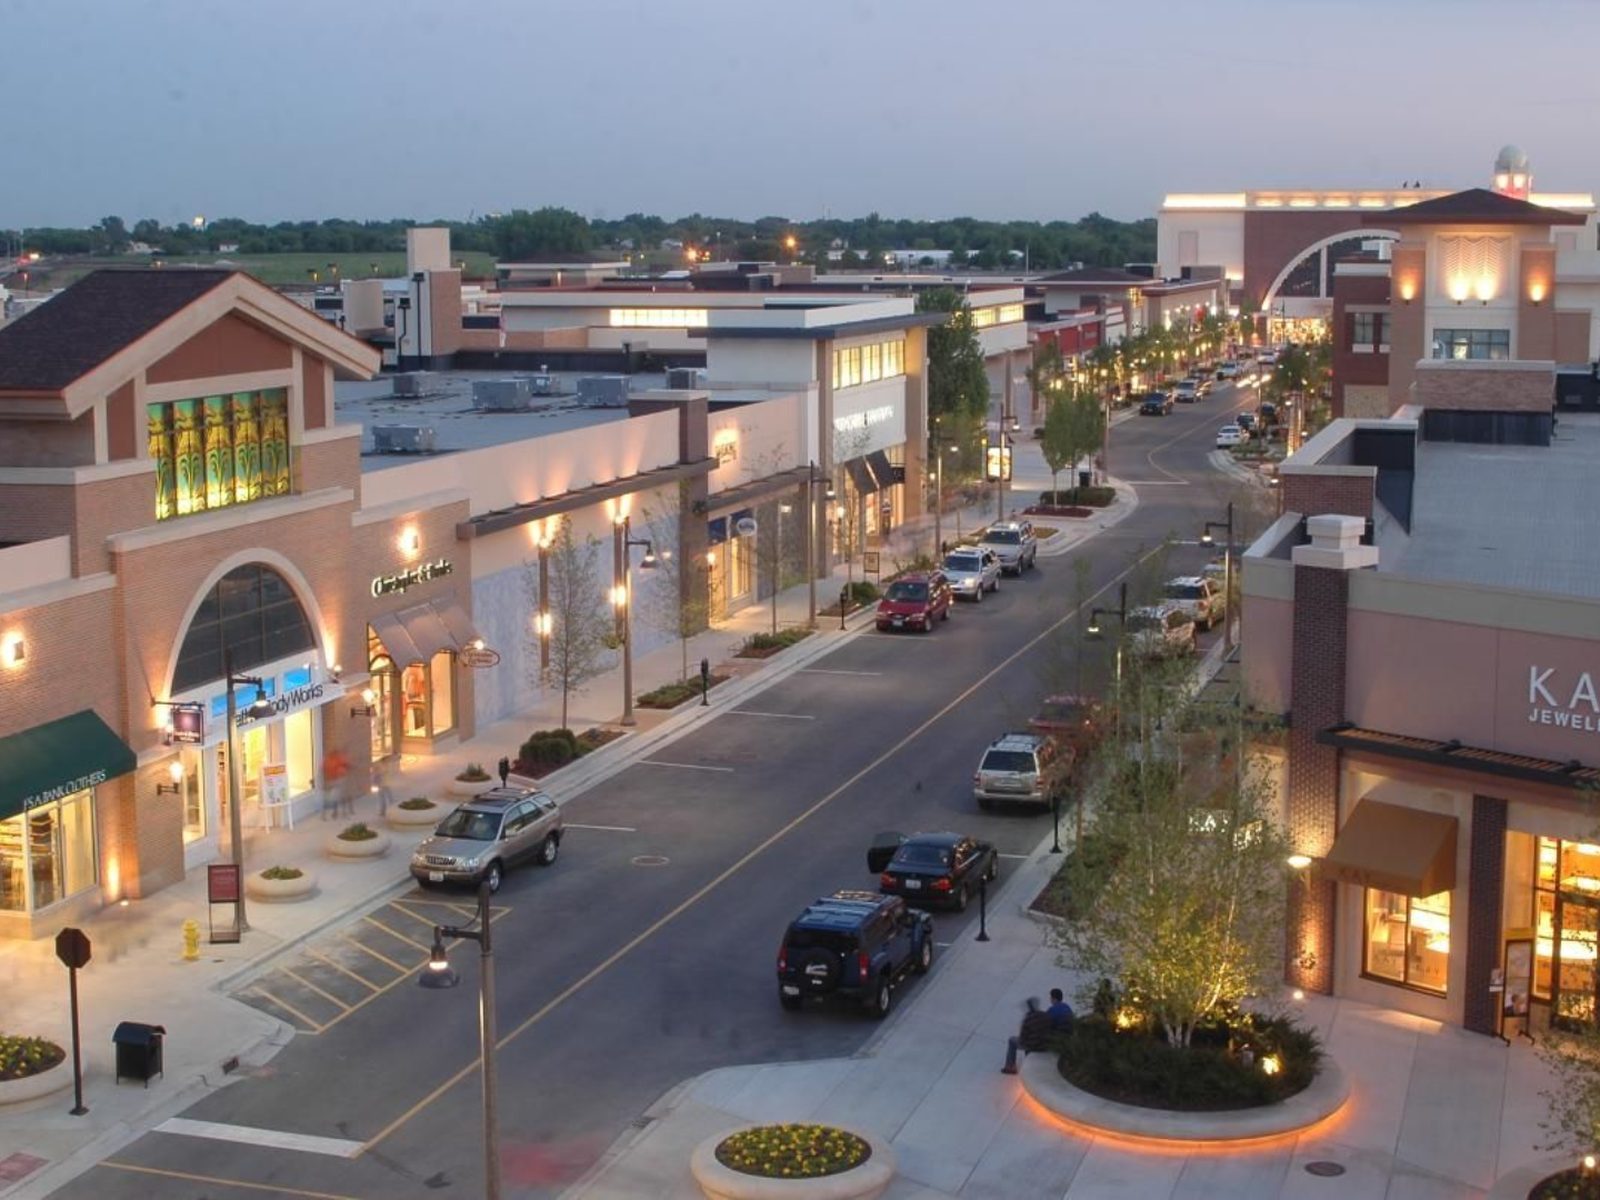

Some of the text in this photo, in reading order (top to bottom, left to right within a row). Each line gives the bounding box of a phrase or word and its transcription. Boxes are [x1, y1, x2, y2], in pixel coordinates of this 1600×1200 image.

[290, 684, 324, 707] Works
[1529, 665, 1600, 712] KA
[1528, 707, 1600, 733] JEWEL
